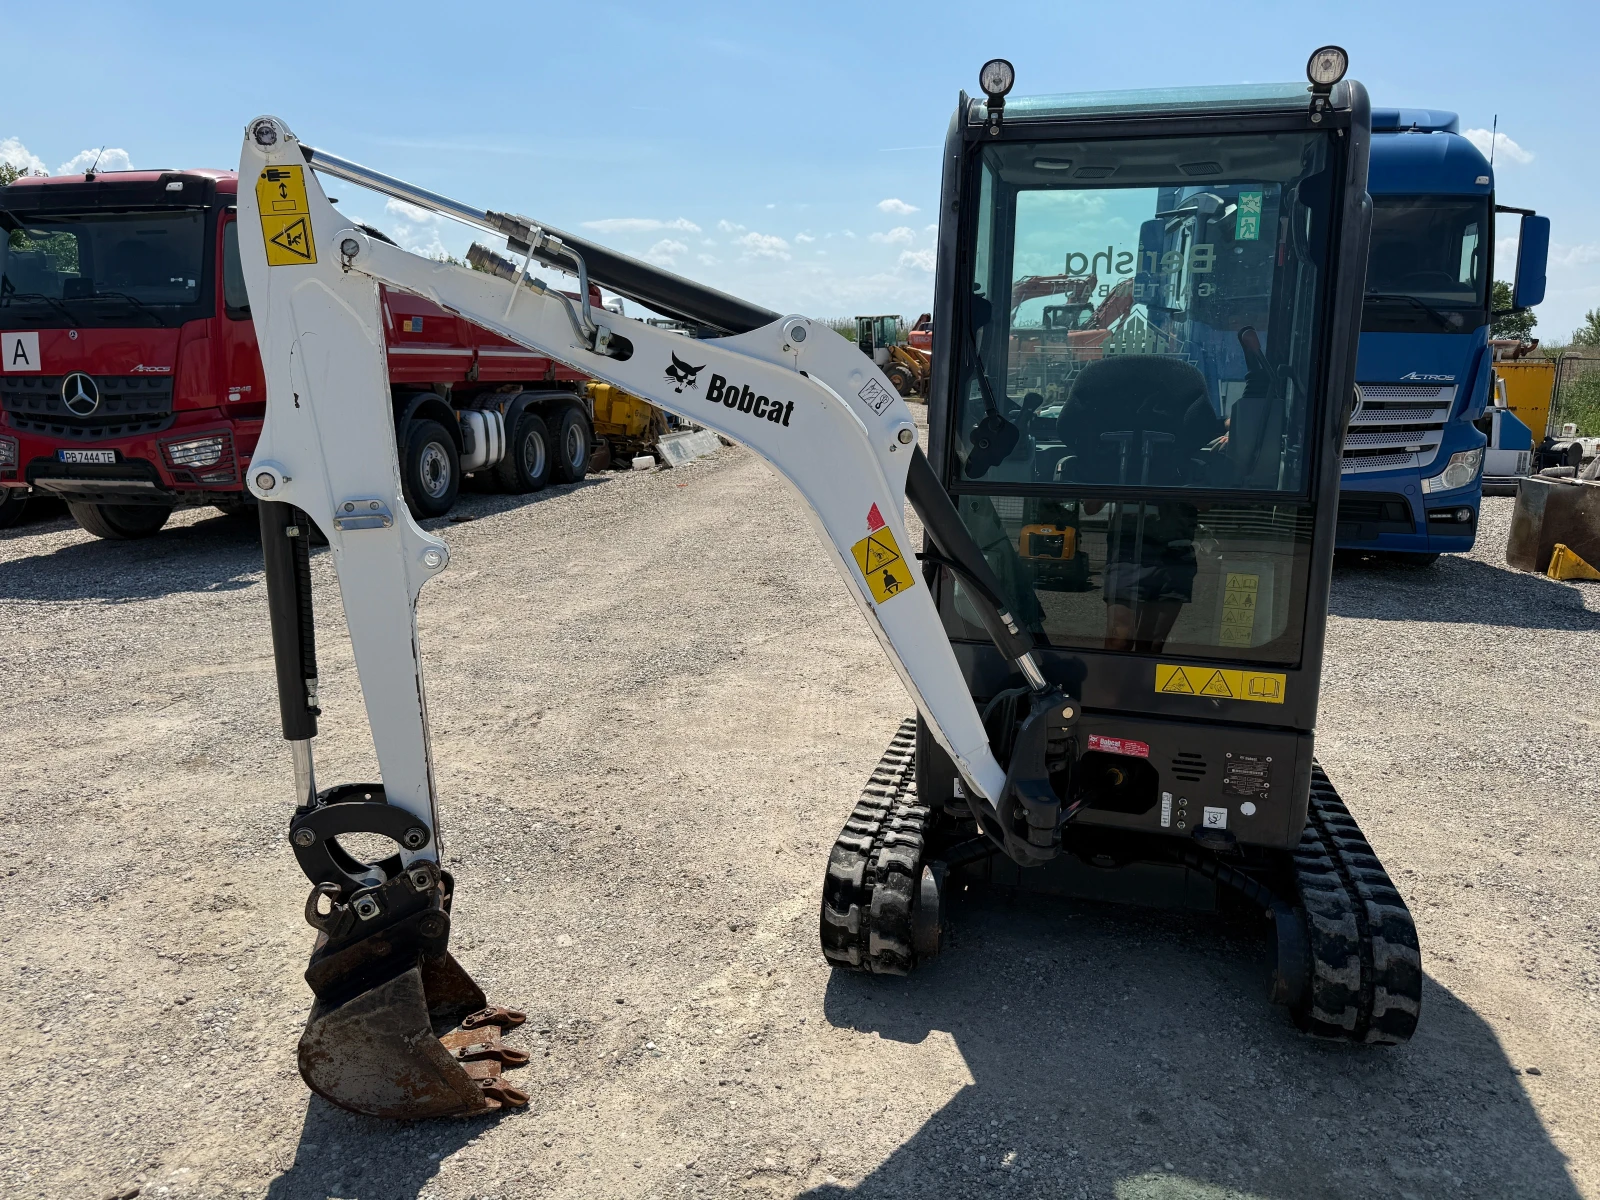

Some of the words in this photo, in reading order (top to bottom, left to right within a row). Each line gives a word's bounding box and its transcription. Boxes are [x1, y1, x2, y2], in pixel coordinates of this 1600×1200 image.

[12, 338, 30, 365] A
[705, 373, 795, 428] Bobcat
[65, 452, 78, 463] PB
[78, 452, 100, 463] 7444
[101, 452, 114, 463] TE
